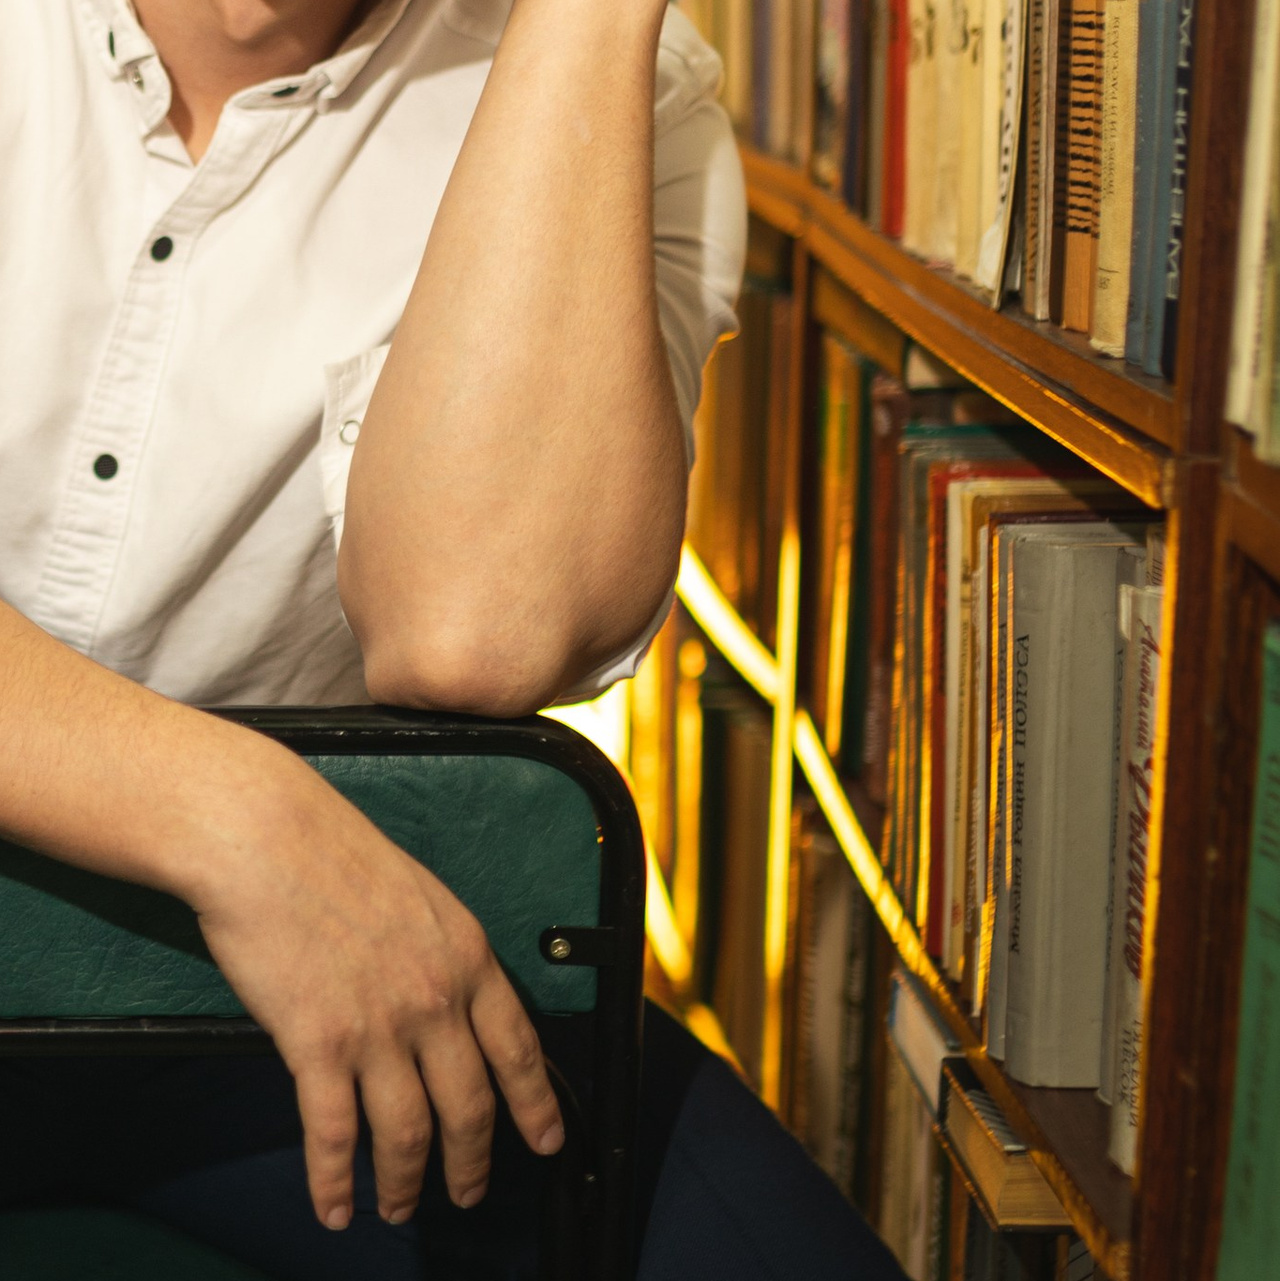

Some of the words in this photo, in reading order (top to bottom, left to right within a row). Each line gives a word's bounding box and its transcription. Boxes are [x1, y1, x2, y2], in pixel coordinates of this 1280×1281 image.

[1015, 632, 1030, 749] ПОЛОСА
[1013, 761, 1026, 847] Рощин
[1009, 856, 1023, 955] Михаил
